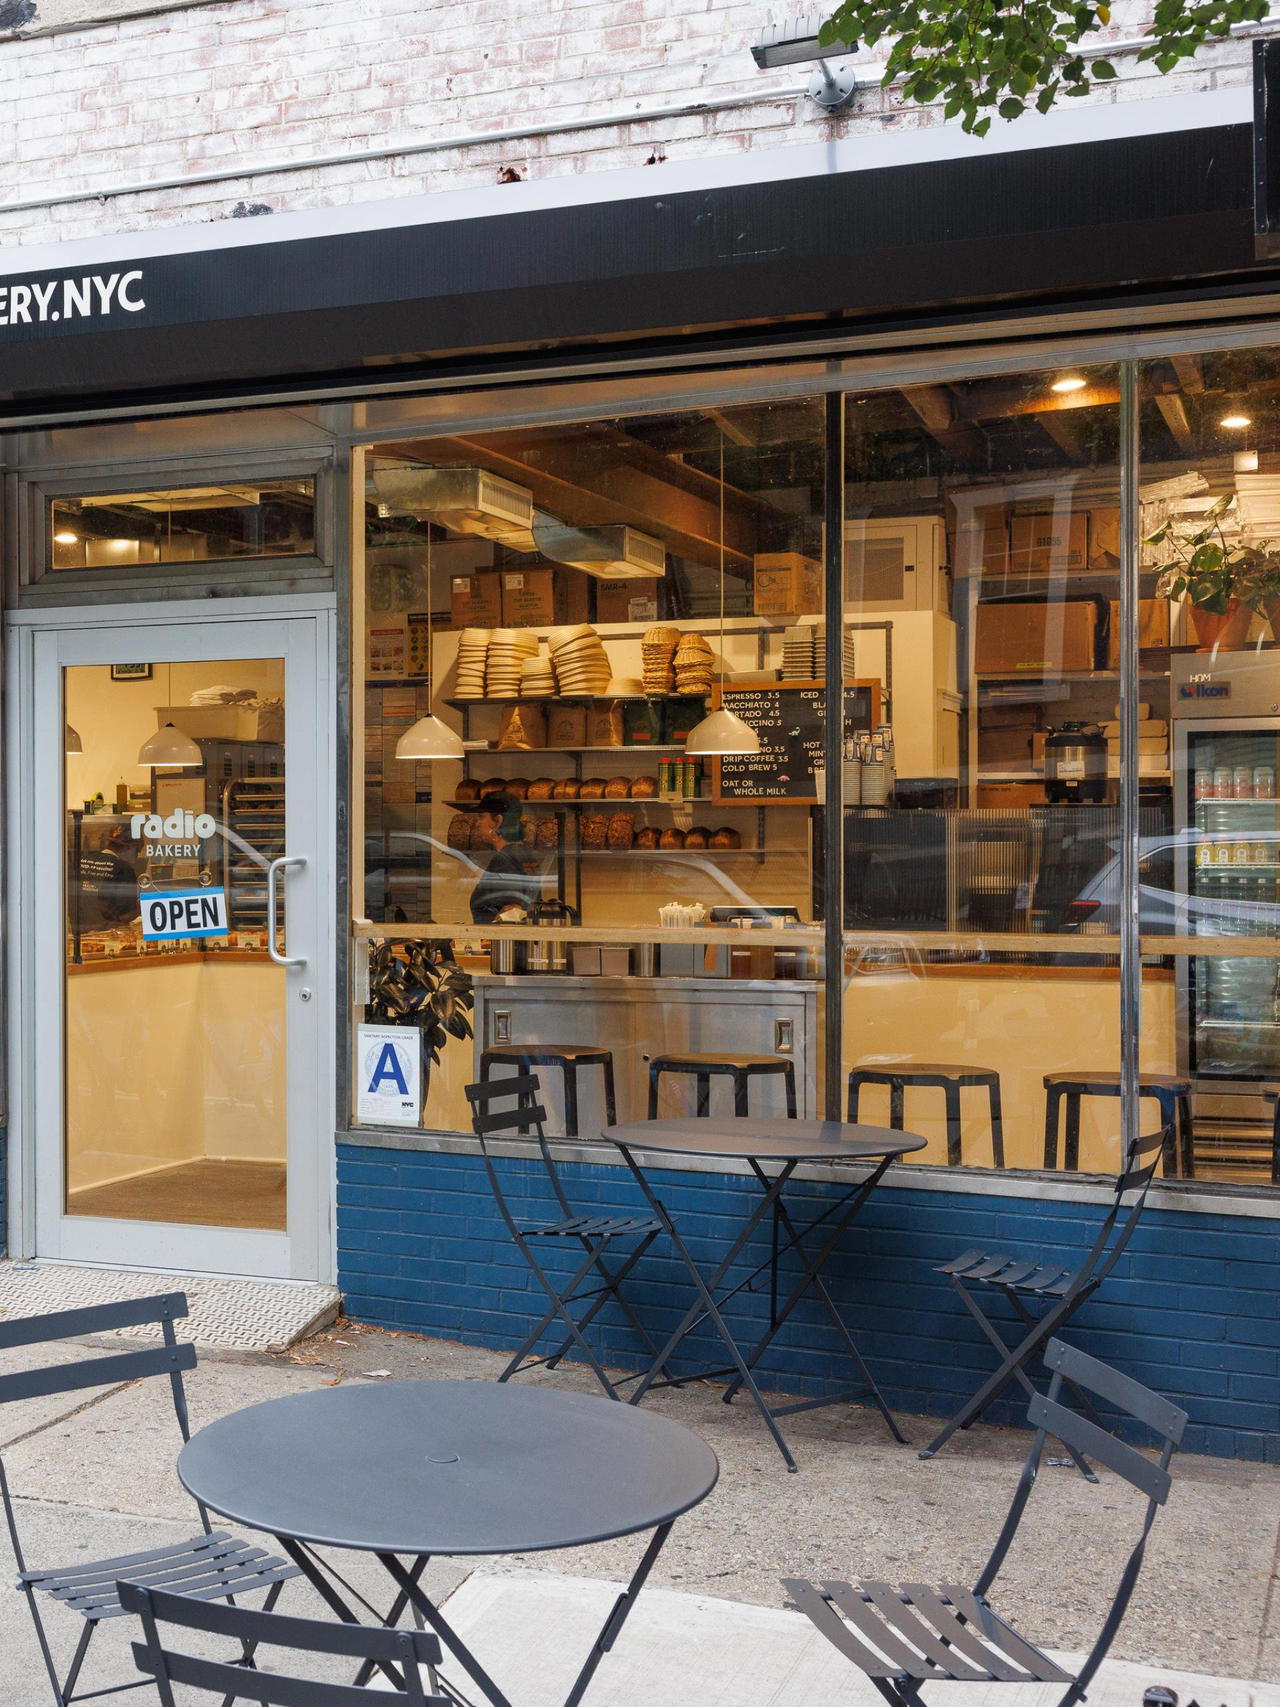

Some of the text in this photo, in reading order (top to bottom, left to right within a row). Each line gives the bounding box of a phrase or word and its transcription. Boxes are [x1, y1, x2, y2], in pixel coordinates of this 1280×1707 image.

[723, 691, 780, 700] ESPRESSO 3.5
[800, 691, 819, 699] ICED
[735, 710, 762, 718] RTADO
[745, 719, 775, 727] CCINO
[803, 741, 821, 749] HOT
[723, 755, 743, 763] DRIP
[743, 754, 776, 763] COFFEE
[808, 750, 826, 758] MIN
[722, 763, 778, 773] COLD BREW 5
[722, 780, 740, 788] OAT
[733, 787, 787, 796] WHOLE MILK
[130, 808, 217, 839] radio
[146, 844, 201, 857] BAKERY
[149, 897, 220, 932] OPEN
[367, 1042, 410, 1095] A
